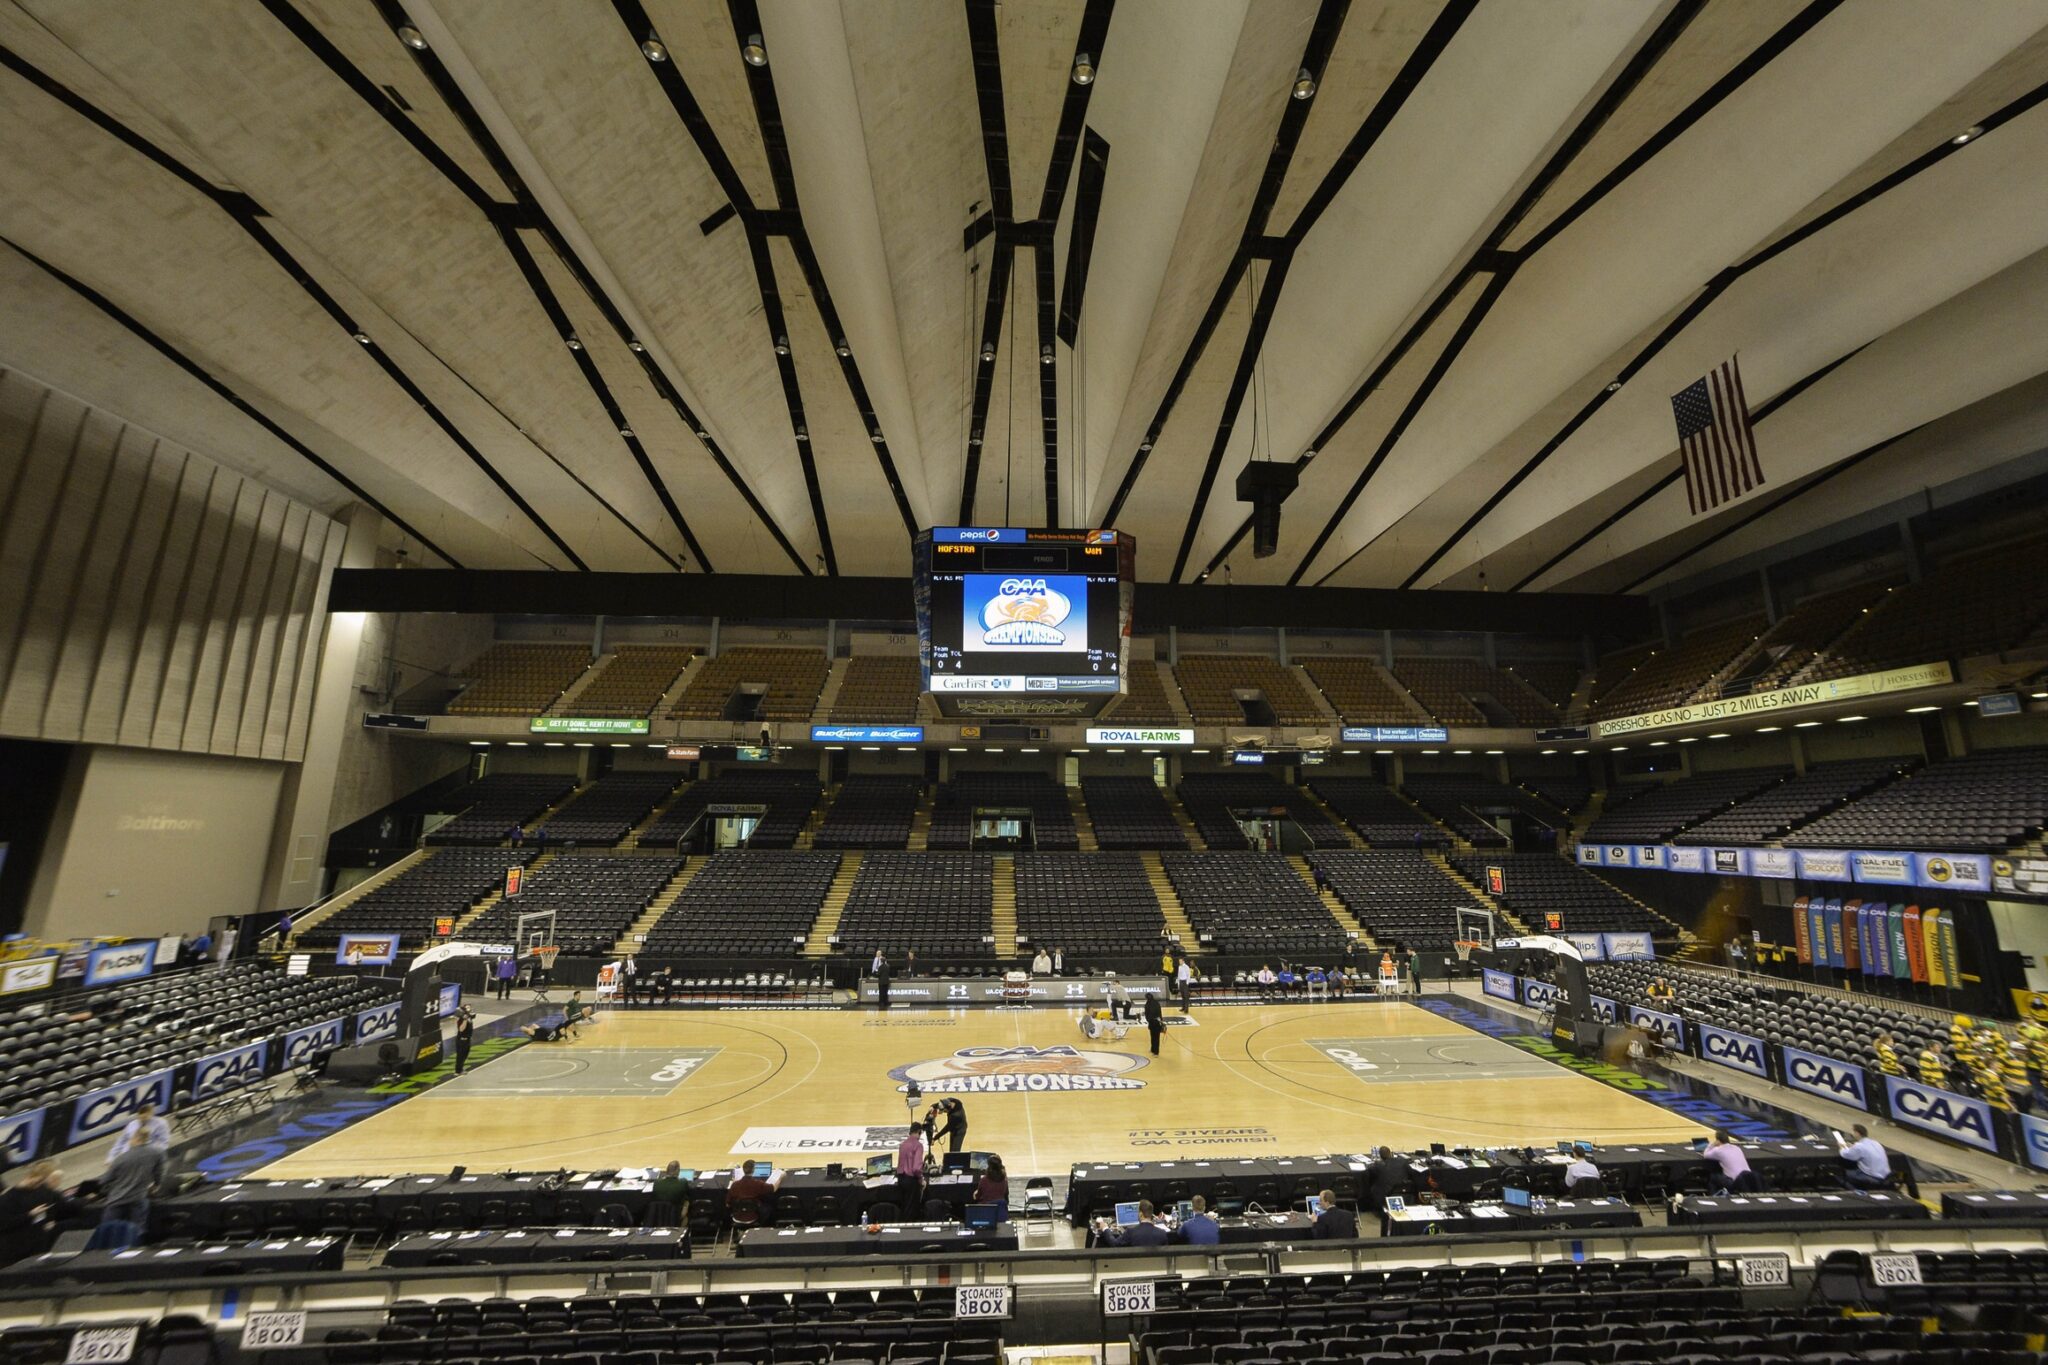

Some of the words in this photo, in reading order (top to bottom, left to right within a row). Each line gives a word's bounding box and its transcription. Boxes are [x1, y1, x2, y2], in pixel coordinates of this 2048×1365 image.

[960, 530, 986, 540] pepsi
[938, 545, 975, 553] HOFSTRA
[999, 578, 1048, 597] CAA
[775, 630, 792, 641] 306
[887, 635, 906, 645] 308
[984, 622, 1066, 645] CHAMPIONSHIP
[938, 661, 944, 669] 0
[956, 661, 962, 669] 4
[1092, 663, 1098, 671] 0
[1110, 663, 1117, 671] 4
[1887, 668, 1947, 685] HORSESHOE
[943, 679, 988, 689] CareFirst
[1028, 680, 1044, 689] MECU
[1600, 717, 1651, 734] HORSESHOE
[1701, 702, 1727, 718] JUST
[1730, 702, 1738, 713] 2
[1740, 693, 1778, 712] MILES
[1781, 686, 1821, 706] AWAY
[570, 720, 588, 728] DONE.
[118, 816, 204, 830] Baltimore
[1856, 858, 1880, 866] DUAL
[438, 926, 450, 936] 30
[1550, 921, 1560, 930] 30
[1831, 923, 1842, 954] DREXEL
[483, 946, 514, 954] GEICO
[1894, 932, 1907, 960] UNCW
[1929, 932, 1944, 972] TOWSON
[1634, 1013, 1682, 1045] CAA
[285, 1025, 337, 1060] CAA
[953, 1044, 1083, 1058] CAA
[1705, 1034, 1763, 1069] CAA
[1326, 1048, 1379, 1070] CAA
[198, 1050, 260, 1086] CAA
[650, 1058, 704, 1082] CAA
[1790, 1058, 1864, 1101] CAA
[78, 1080, 164, 1131] CAA
[1894, 1088, 1991, 1142] CAA
[741, 1138, 794, 1149] Visit
[798, 1138, 906, 1148] Baltimo
[1178, 1136, 1278, 1145] COMMISH
[1752, 1260, 1784, 1270] COACHES
[1882, 1257, 1913, 1268] COACHES
[1755, 1270, 1784, 1282] BOX
[1888, 1269, 1916, 1283] BOX
[968, 1288, 1003, 1300] COACHES
[1116, 1284, 1150, 1296] COACHES
[960, 1290, 968, 1315] CAA
[1108, 1287, 1116, 1312] CAA
[1117, 1296, 1150, 1311] BOX
[968, 1300, 1003, 1314] BOX
[258, 1327, 299, 1344] BOX
